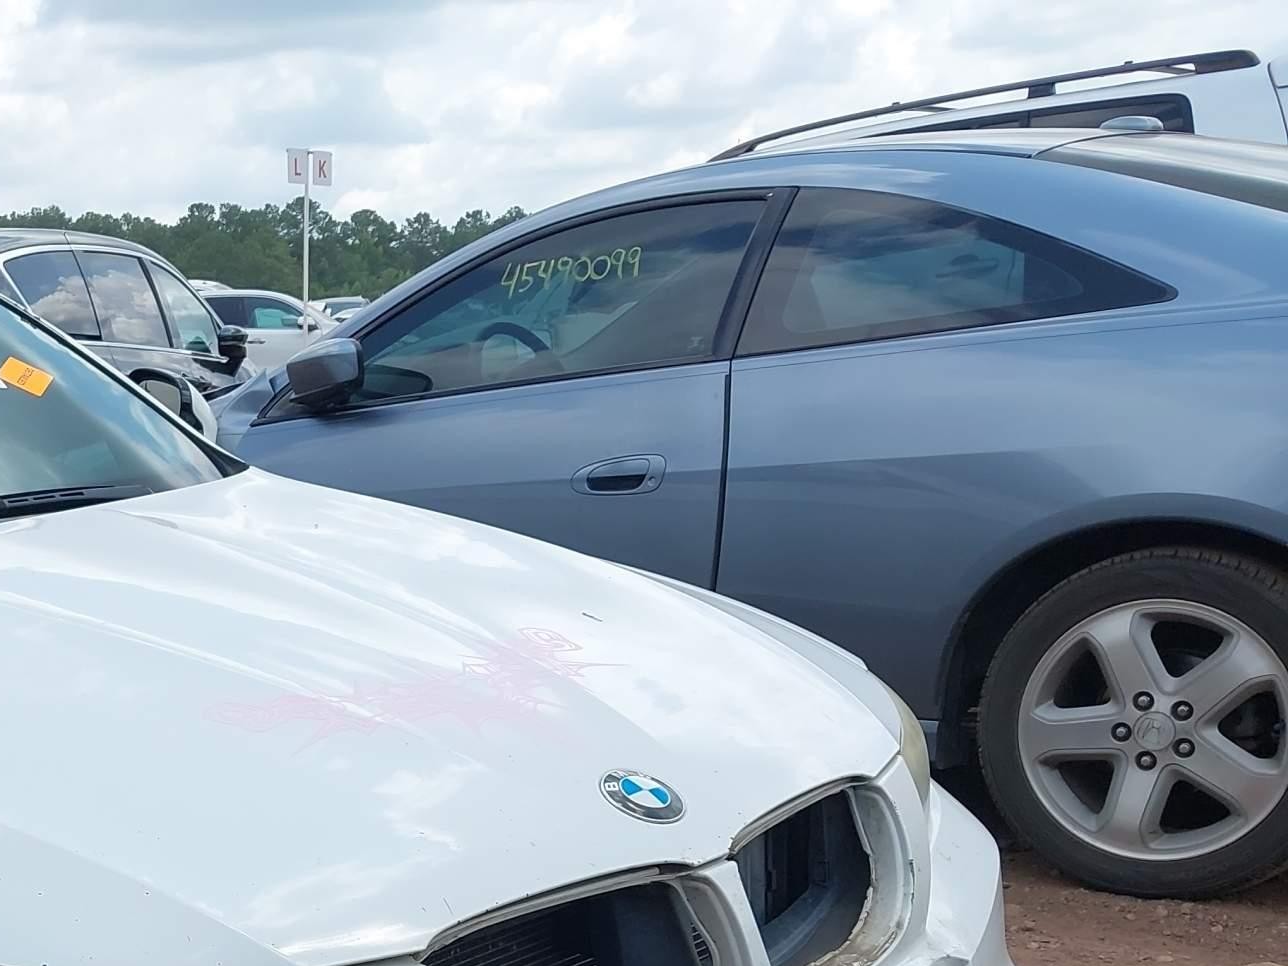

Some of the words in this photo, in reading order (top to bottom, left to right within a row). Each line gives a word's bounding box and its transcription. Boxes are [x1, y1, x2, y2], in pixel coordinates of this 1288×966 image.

[294, 158, 302, 177] L
[318, 159, 327, 178] K
[501, 247, 642, 300] 45490099
